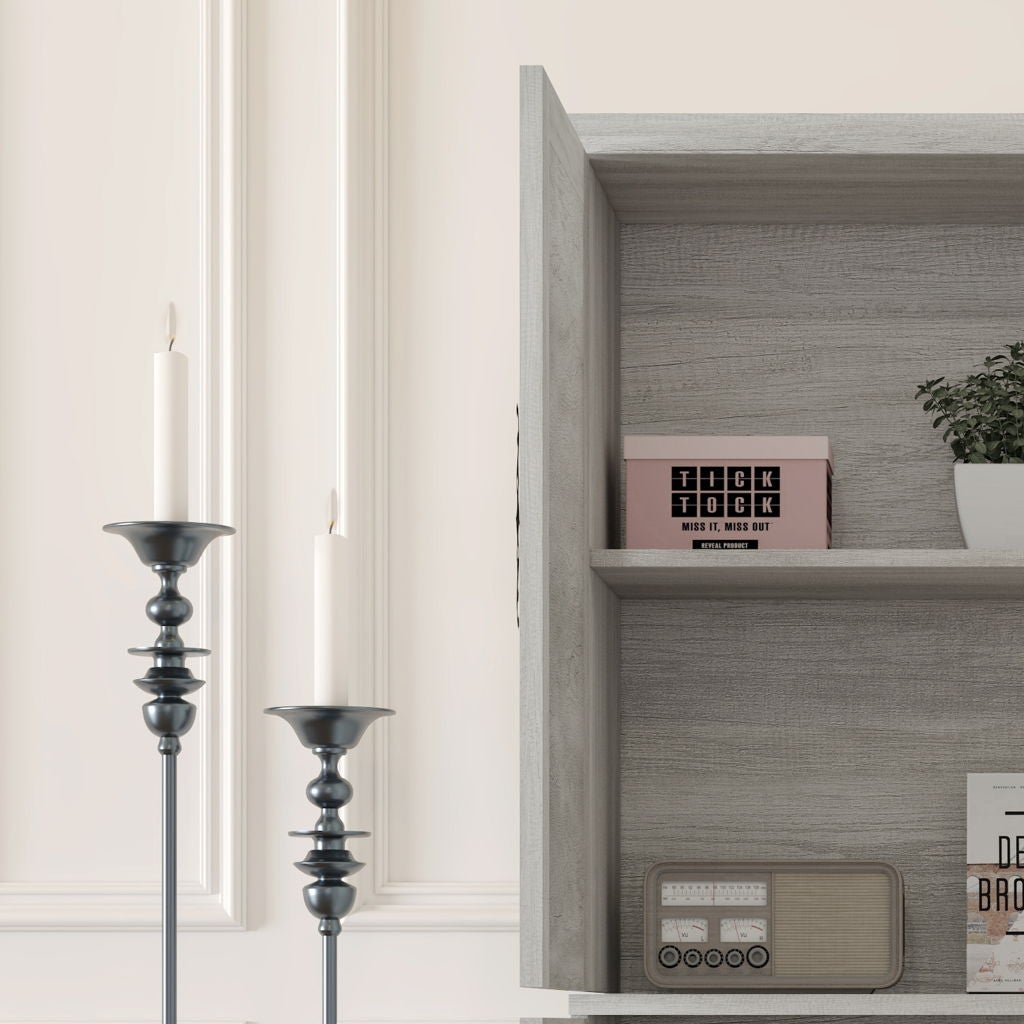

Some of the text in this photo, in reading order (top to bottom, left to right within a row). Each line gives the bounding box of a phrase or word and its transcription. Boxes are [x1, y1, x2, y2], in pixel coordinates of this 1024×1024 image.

[678, 470, 774, 488] TICK
[678, 496, 774, 514] TOCK
[681, 522, 770, 533] MISS IT, MISS OUT
